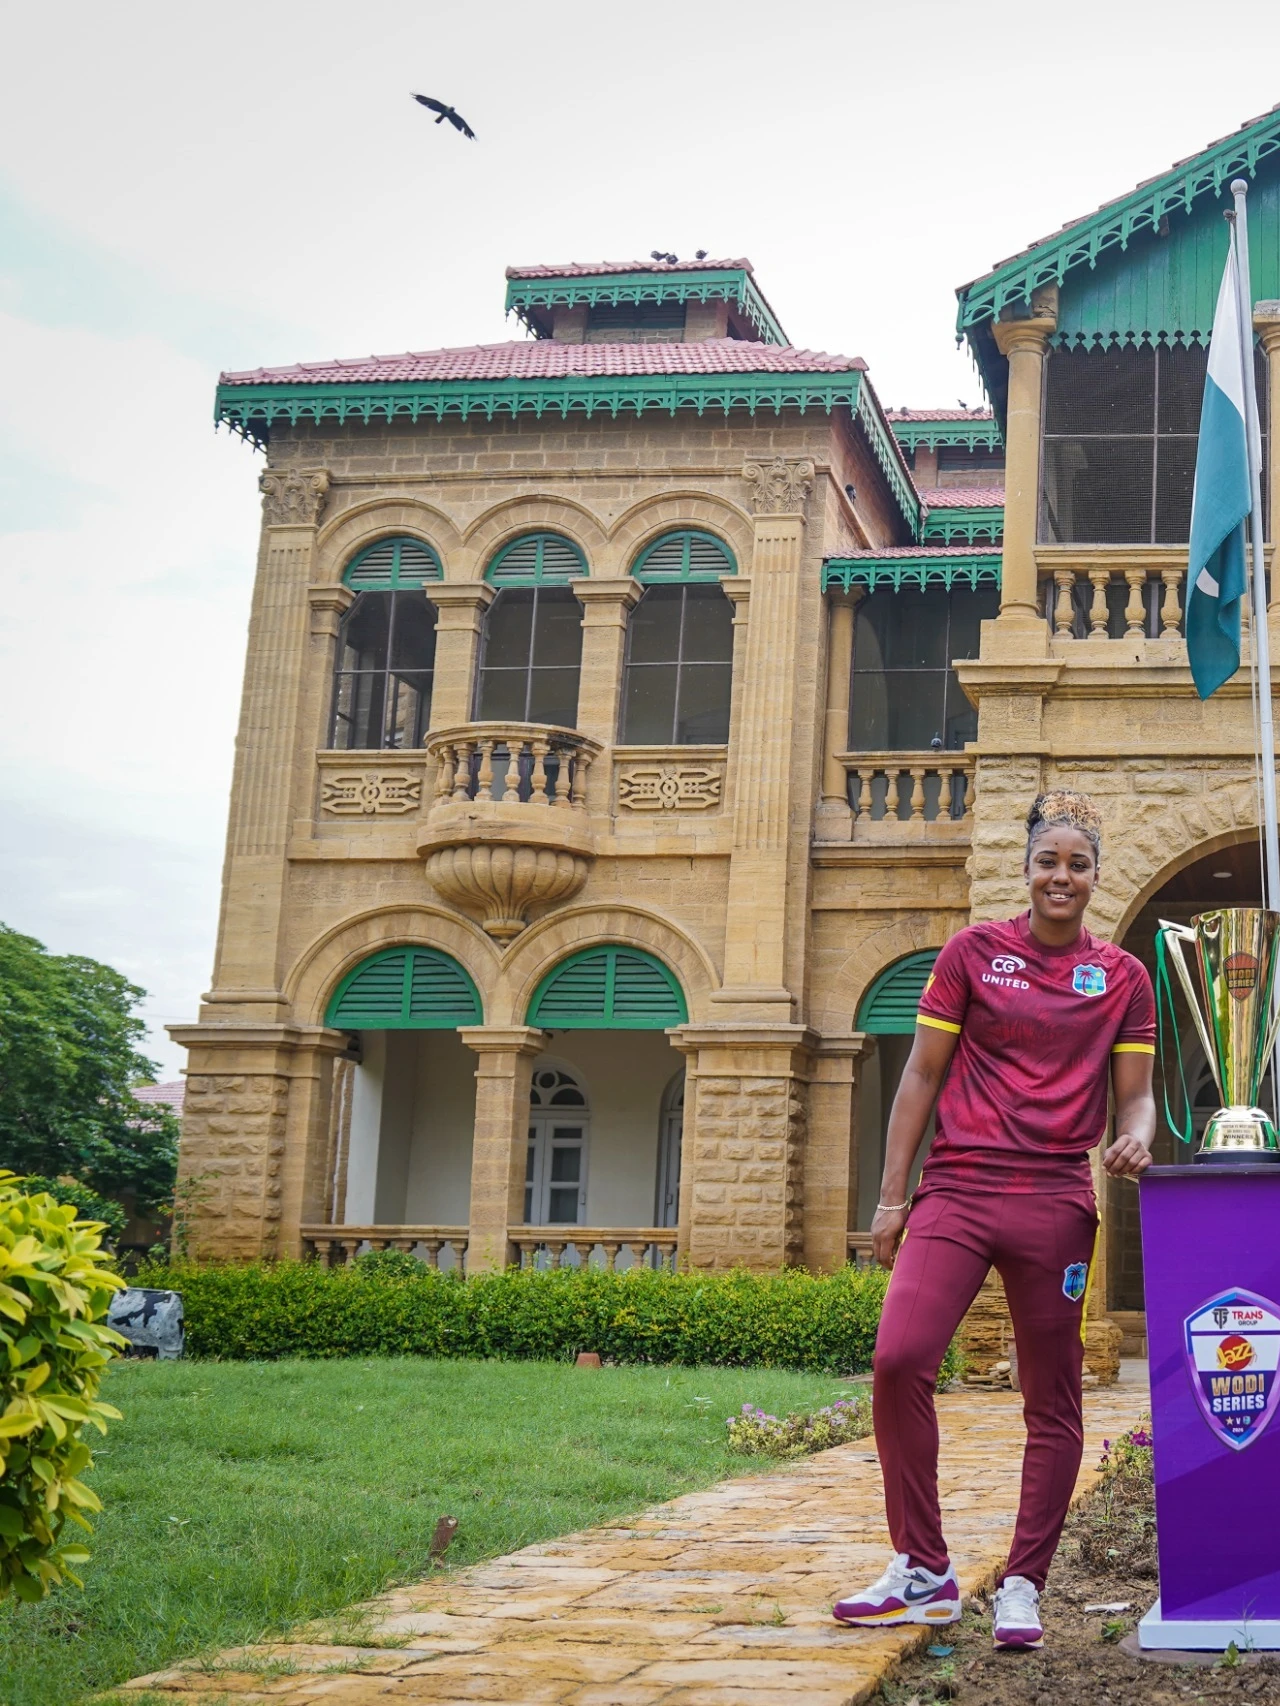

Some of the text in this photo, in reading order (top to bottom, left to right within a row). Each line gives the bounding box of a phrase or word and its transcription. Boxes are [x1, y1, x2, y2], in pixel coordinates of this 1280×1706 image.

[992, 959, 1015, 973] CG
[982, 973, 1030, 990] UNITED
[1227, 968, 1255, 980] WODI
[1228, 979, 1255, 988] SERIES
[1232, 1311, 1263, 1320] TRANS
[1217, 1343, 1254, 1369] Jazz
[1212, 1374, 1264, 1396] WODI
[1213, 1394, 1264, 1412] SERIES
